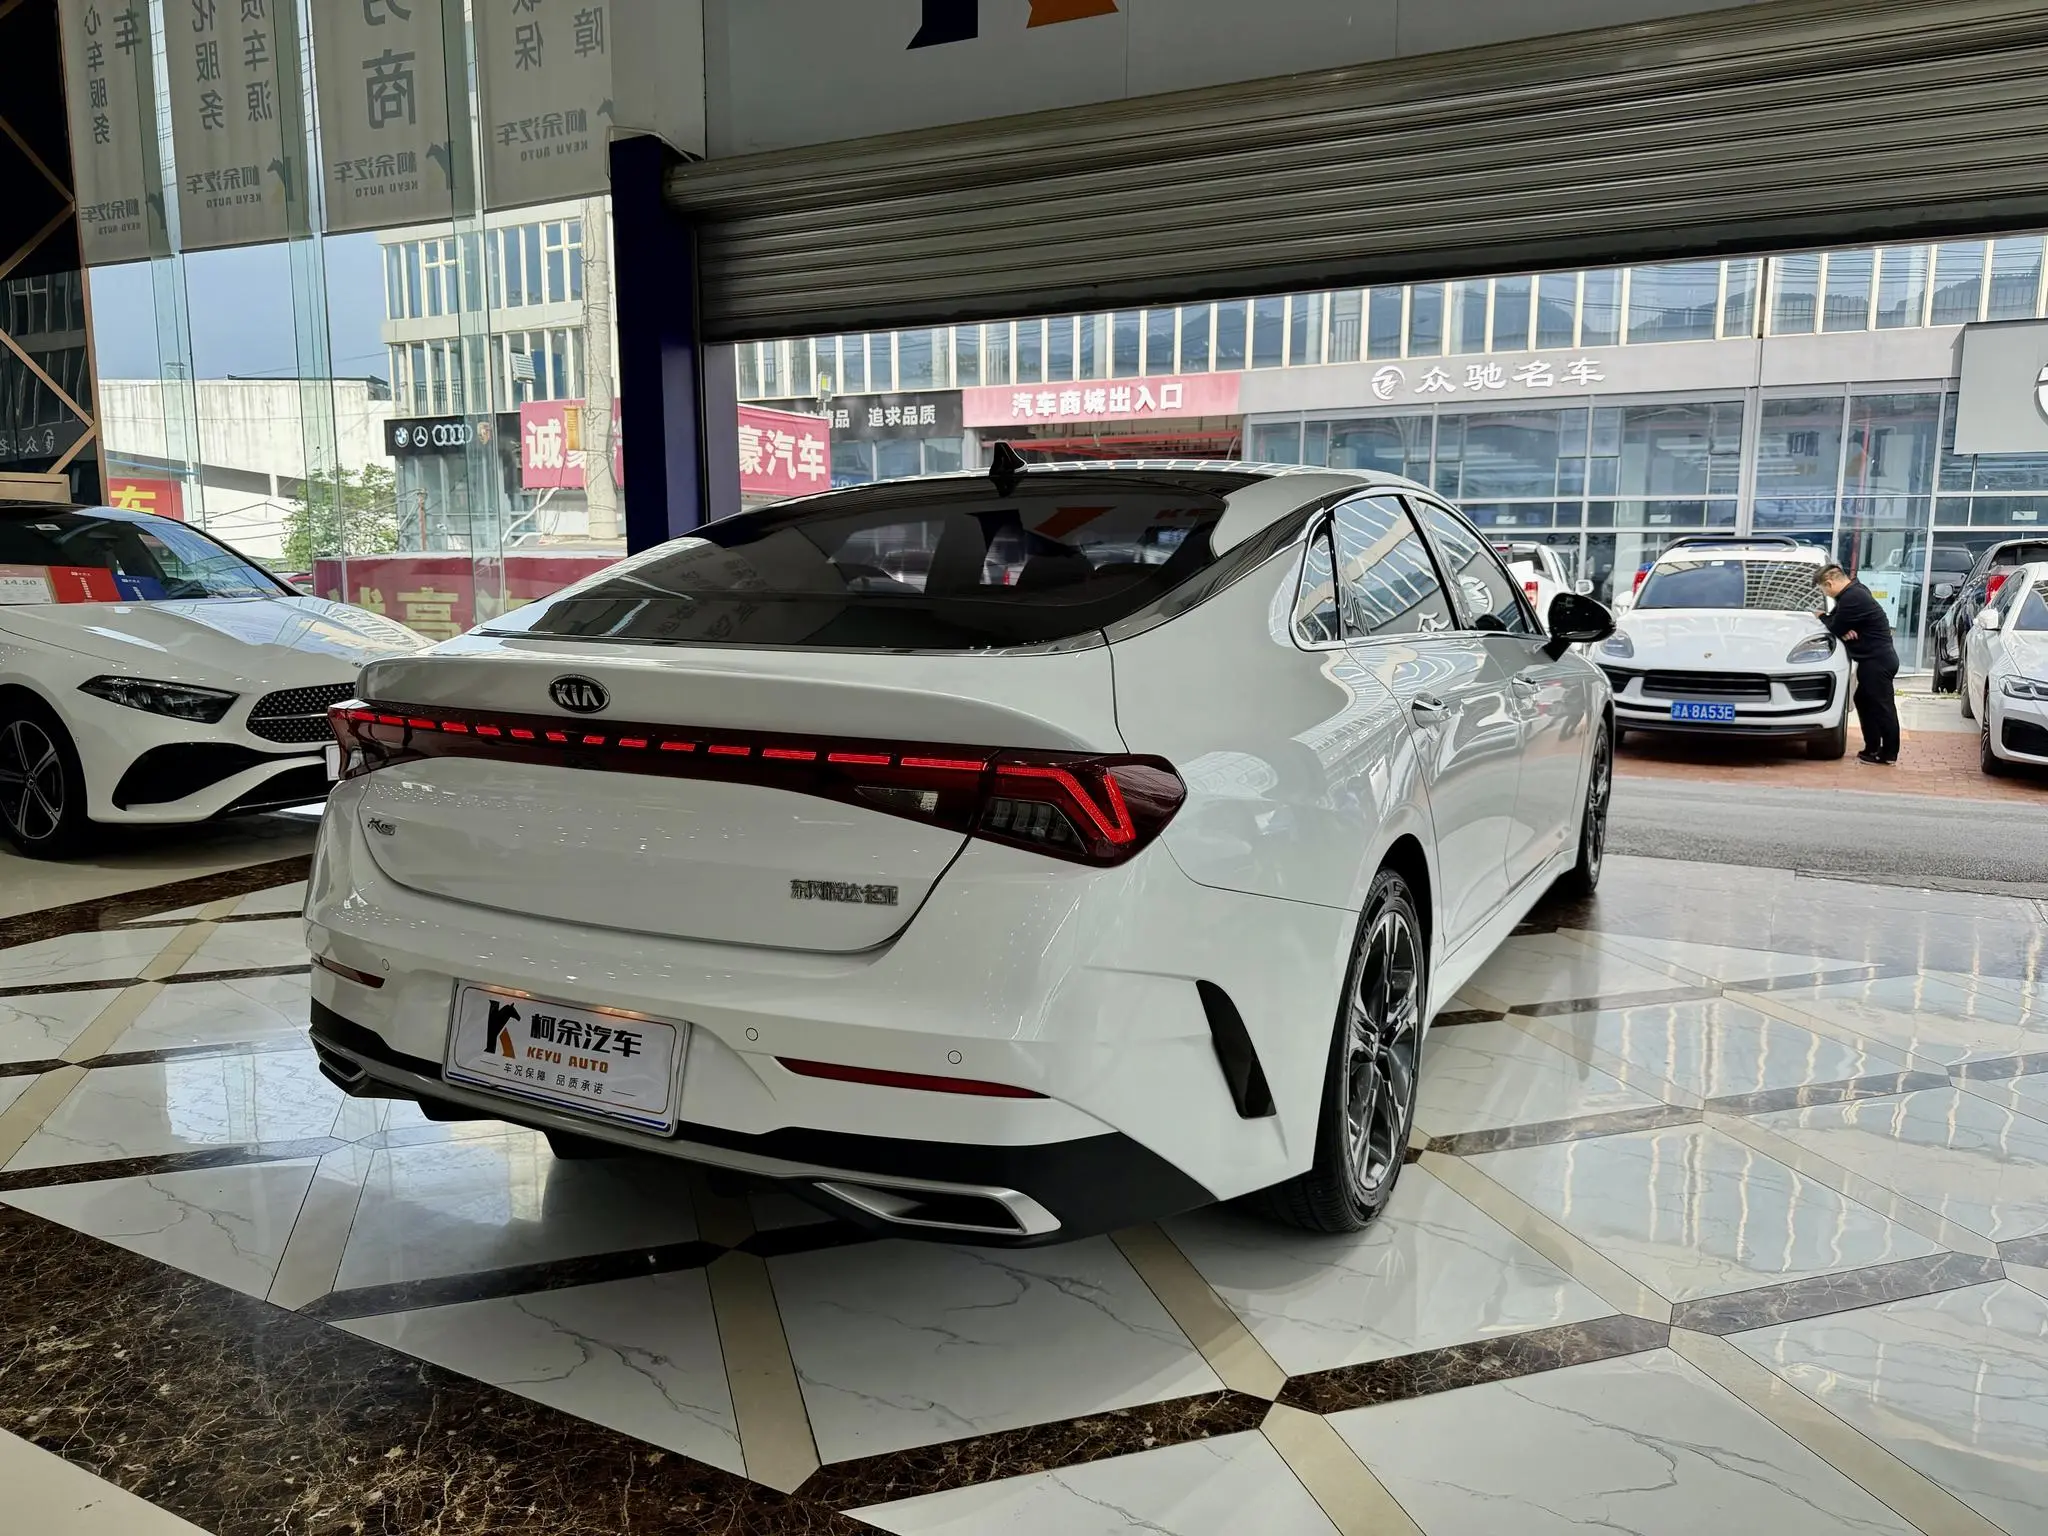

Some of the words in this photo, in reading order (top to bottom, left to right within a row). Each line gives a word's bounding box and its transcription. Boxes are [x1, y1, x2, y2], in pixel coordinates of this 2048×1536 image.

[1414, 357, 1606, 393] 众驰名车
[868, 404, 936, 427] 追求品质
[1011, 383, 1183, 417] 汽车商城出入口
[739, 425, 826, 482] 豪汽车
[554, 683, 600, 707] KIA
[530, 1013, 642, 1057] 柯余汽车
[527, 1046, 561, 1064] KEYU
[569, 1056, 608, 1073] AUTO
[503, 1063, 546, 1081] 车况保障
[556, 1074, 604, 1094] 品质承诺
